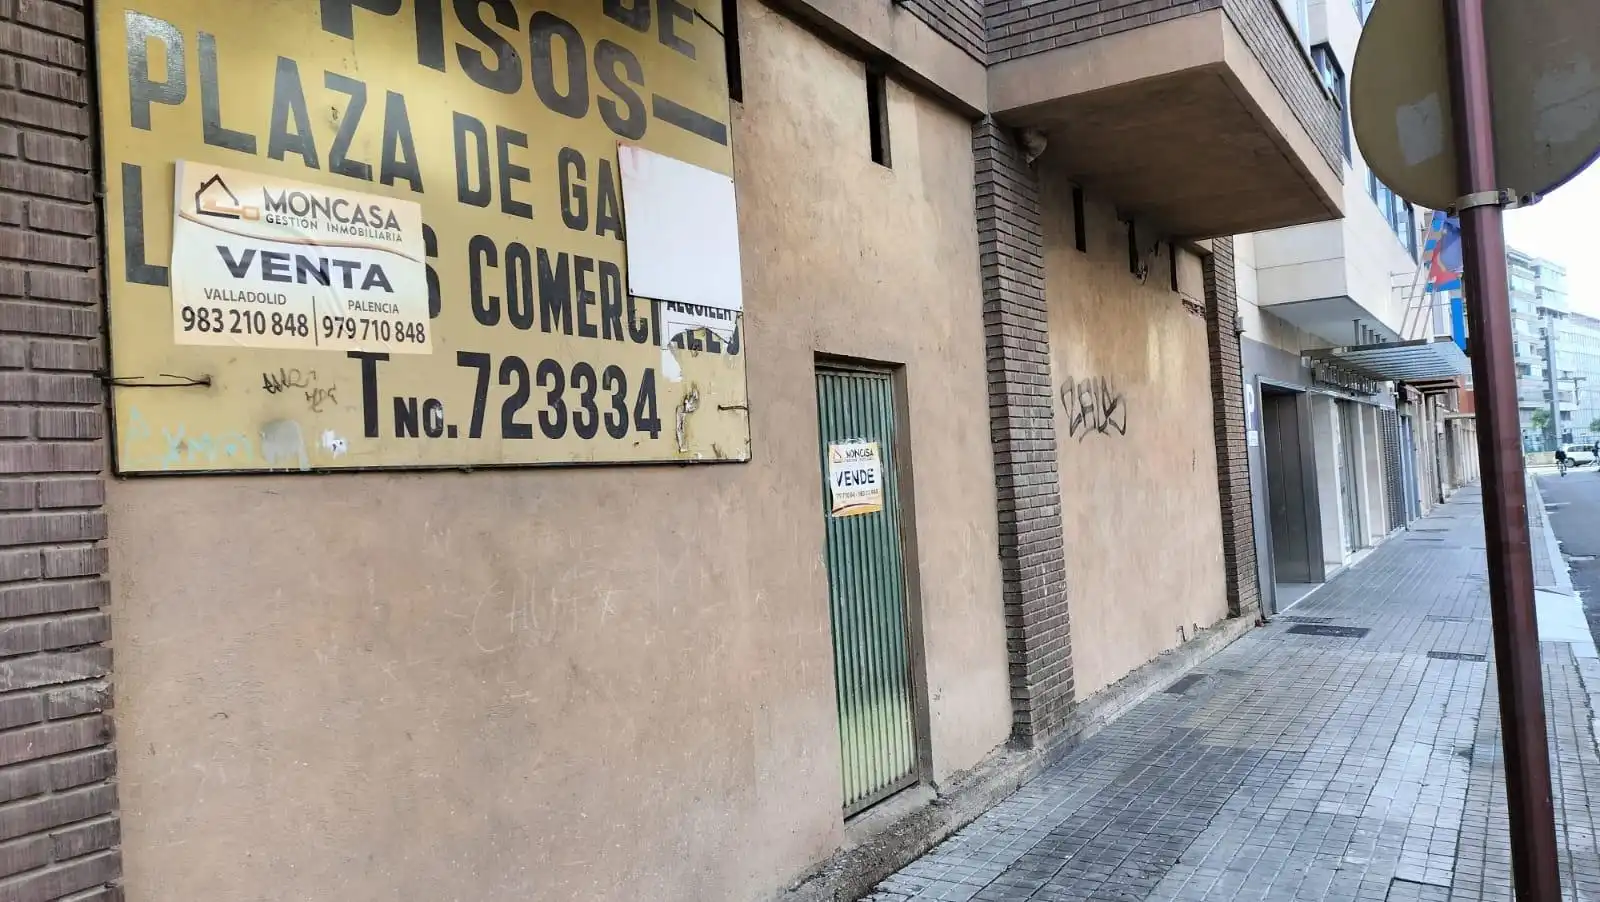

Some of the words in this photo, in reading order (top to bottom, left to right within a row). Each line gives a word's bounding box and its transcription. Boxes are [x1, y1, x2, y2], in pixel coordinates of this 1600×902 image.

[124, 9, 424, 194] PLAZA
[453, 111, 533, 220] DE
[263, 186, 401, 232] MONCASA
[327, 222, 403, 242] INMOBILIARIA
[216, 245, 394, 293] VENTA
[203, 287, 287, 306] VALLADOLID
[348, 299, 400, 315] PALENCIA
[181, 305, 224, 334] 983
[229, 309, 266, 336] 210
[271, 312, 309, 338] 848
[322, 315, 356, 340] 979
[362, 319, 391, 342] 710
[394, 321, 426, 344] 848
[836, 468, 875, 487] VENDE
